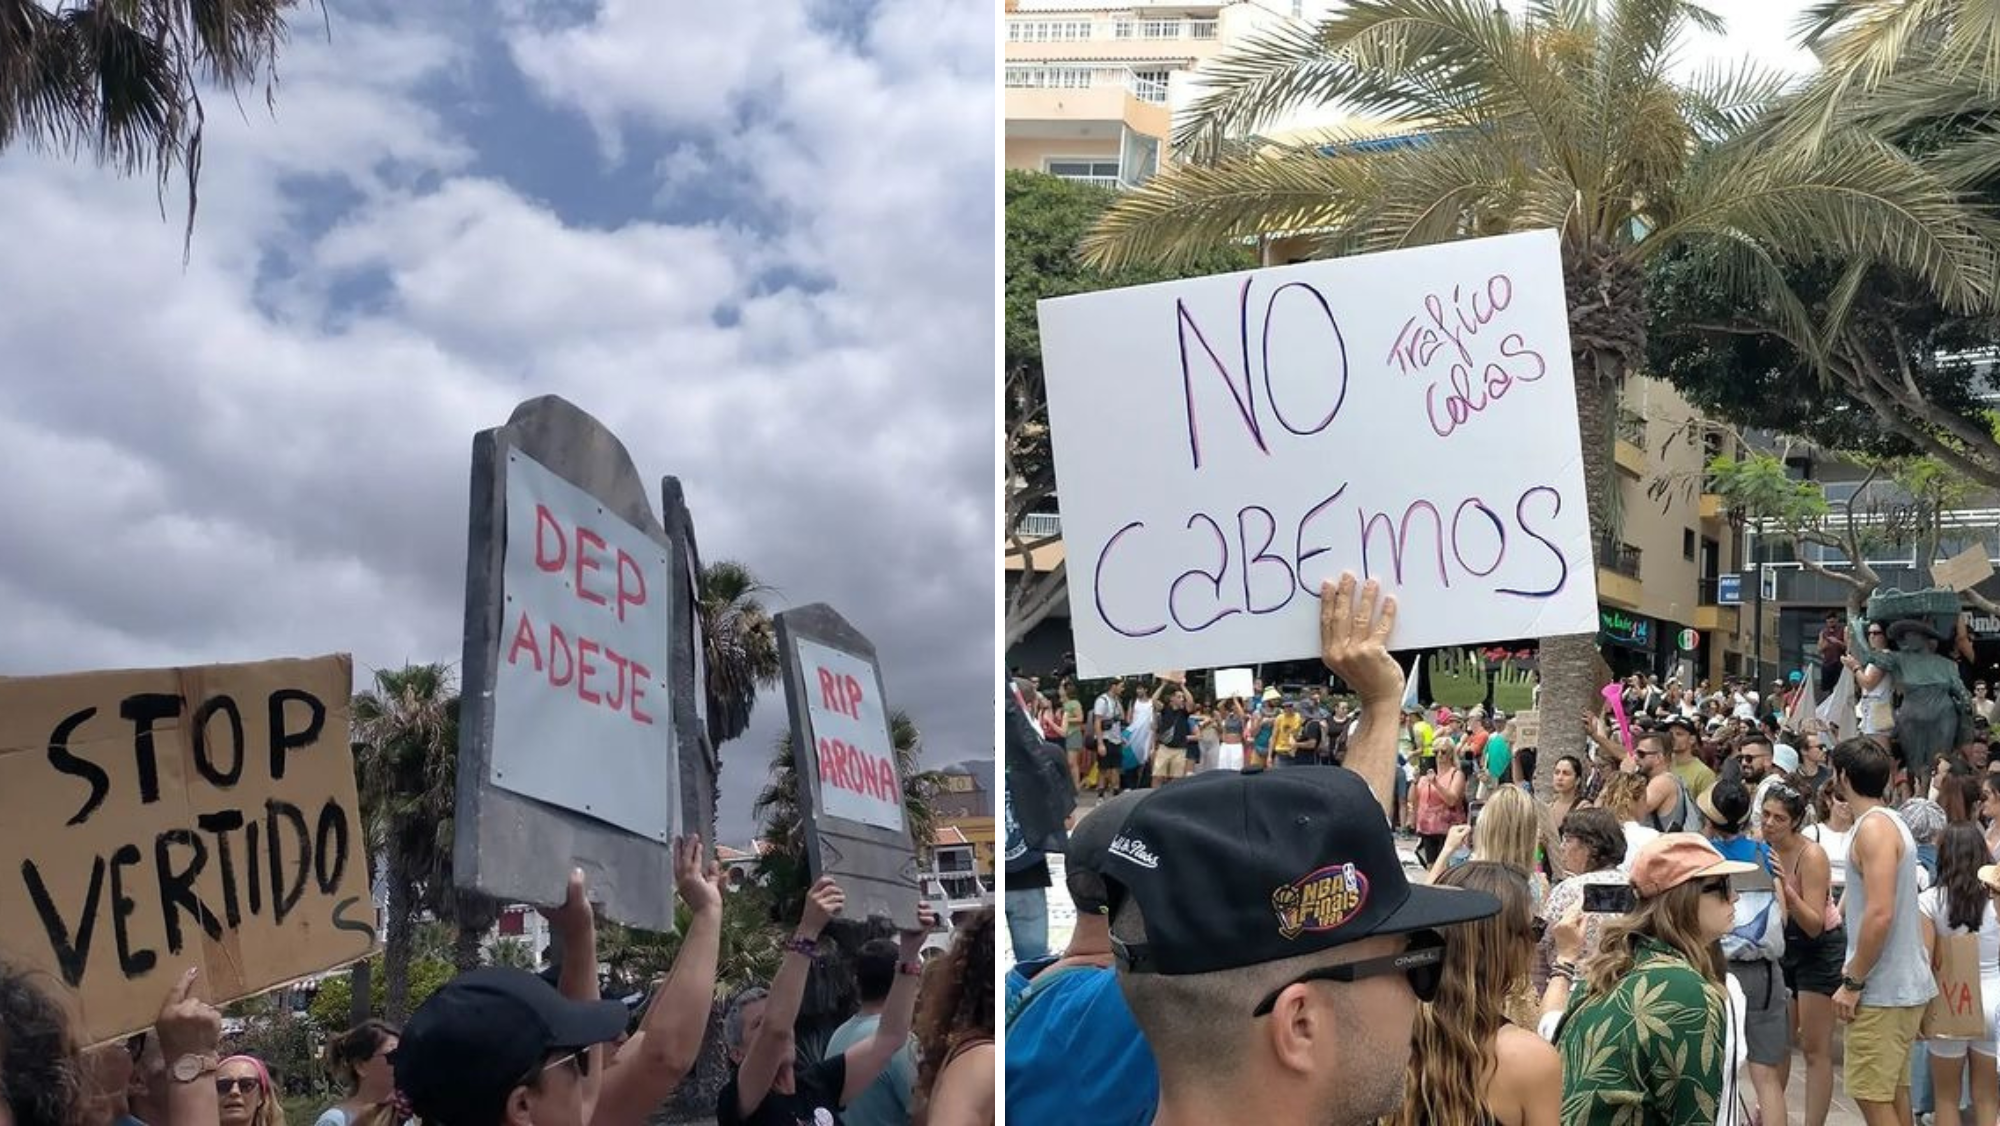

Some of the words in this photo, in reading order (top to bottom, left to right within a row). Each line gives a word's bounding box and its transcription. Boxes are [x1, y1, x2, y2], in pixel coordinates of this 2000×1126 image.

[1176, 276, 1348, 469] NO
[535, 503, 647, 622] DEP
[507, 611, 654, 725] ADEJE
[817, 666, 863, 720] RIP
[47, 688, 327, 827] STOP
[818, 737, 899, 805] ARONA
[1303, 874, 1345, 903] NBA
[1942, 981, 1972, 1016] YA
